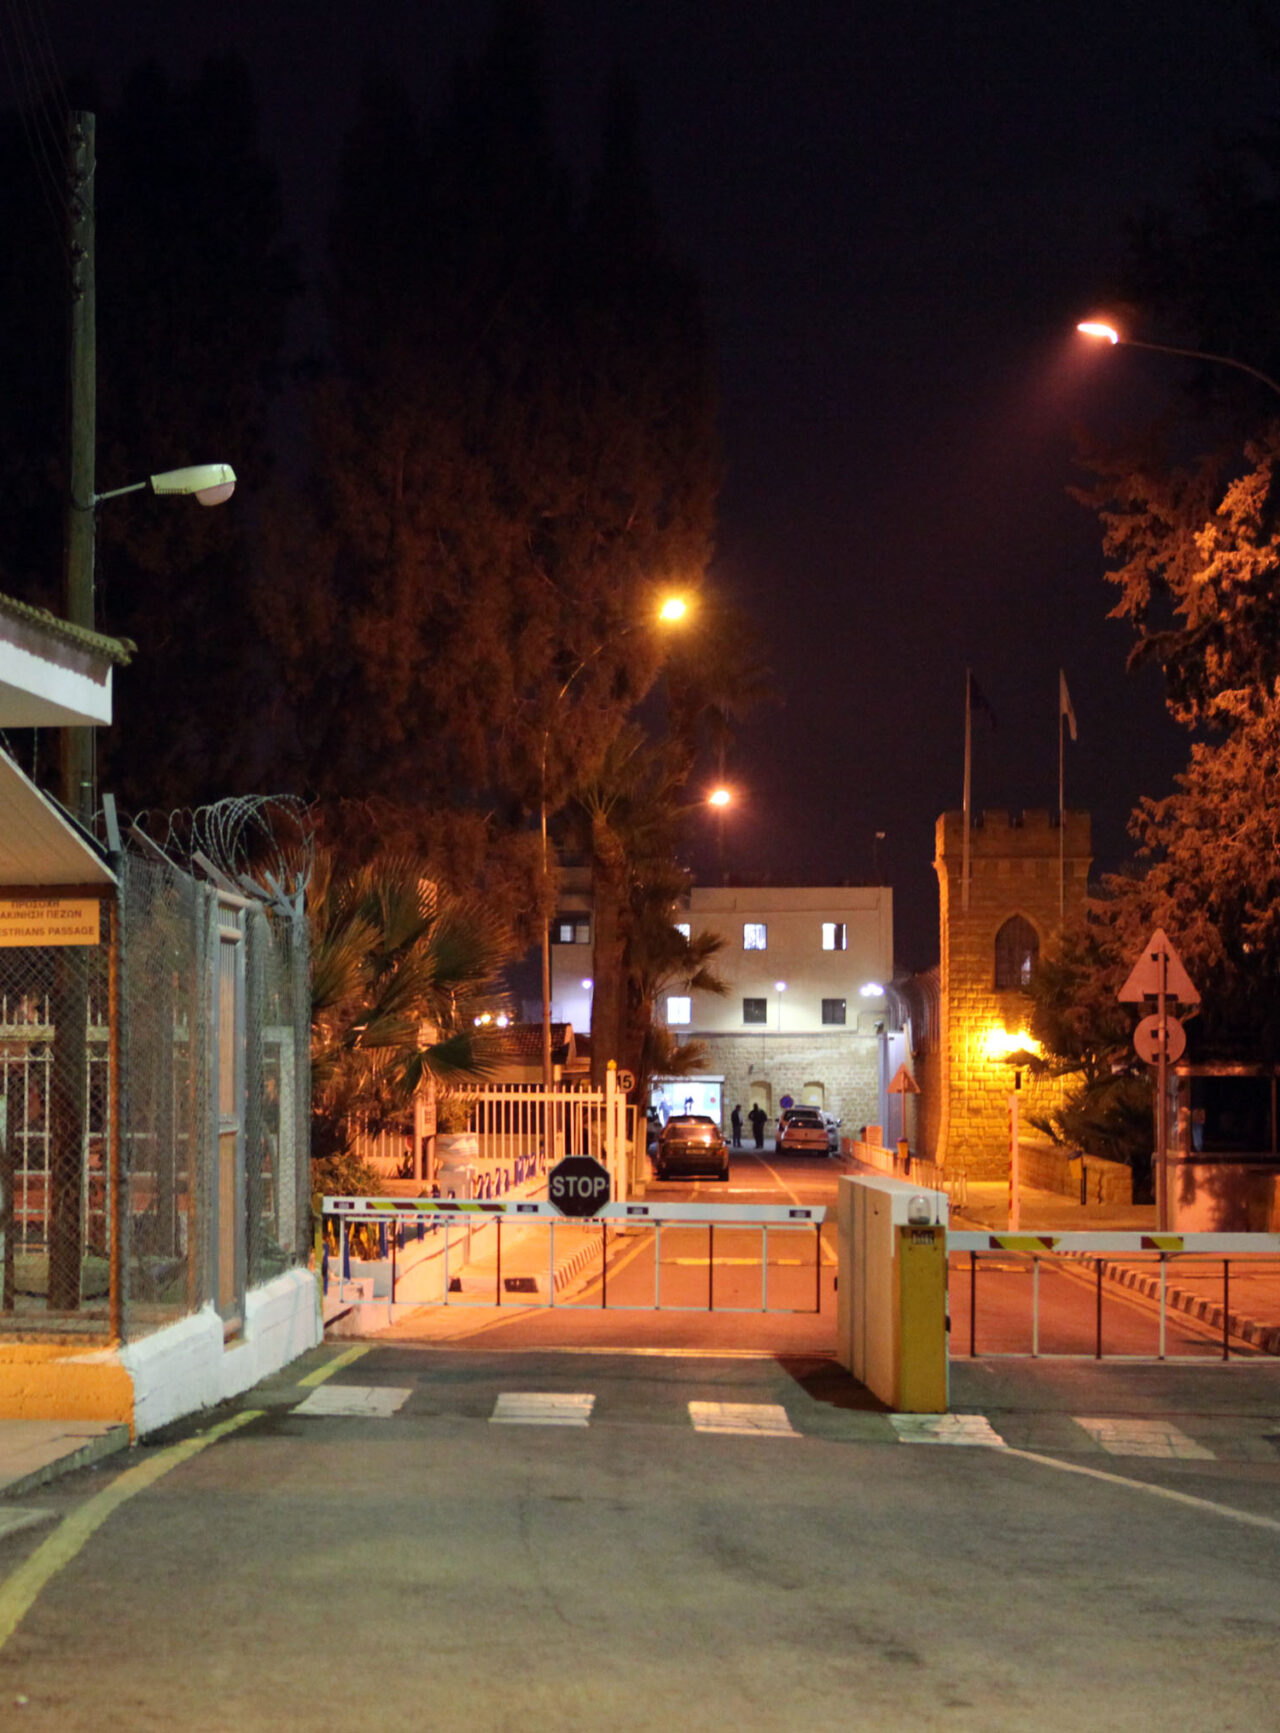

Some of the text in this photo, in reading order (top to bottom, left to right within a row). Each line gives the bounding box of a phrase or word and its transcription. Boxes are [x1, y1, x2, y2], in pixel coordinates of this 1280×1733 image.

[46, 909, 82, 919] ΠΕΖΩΝ
[48, 926, 95, 936] PASSAGE
[552, 1176, 606, 1198] STOP
